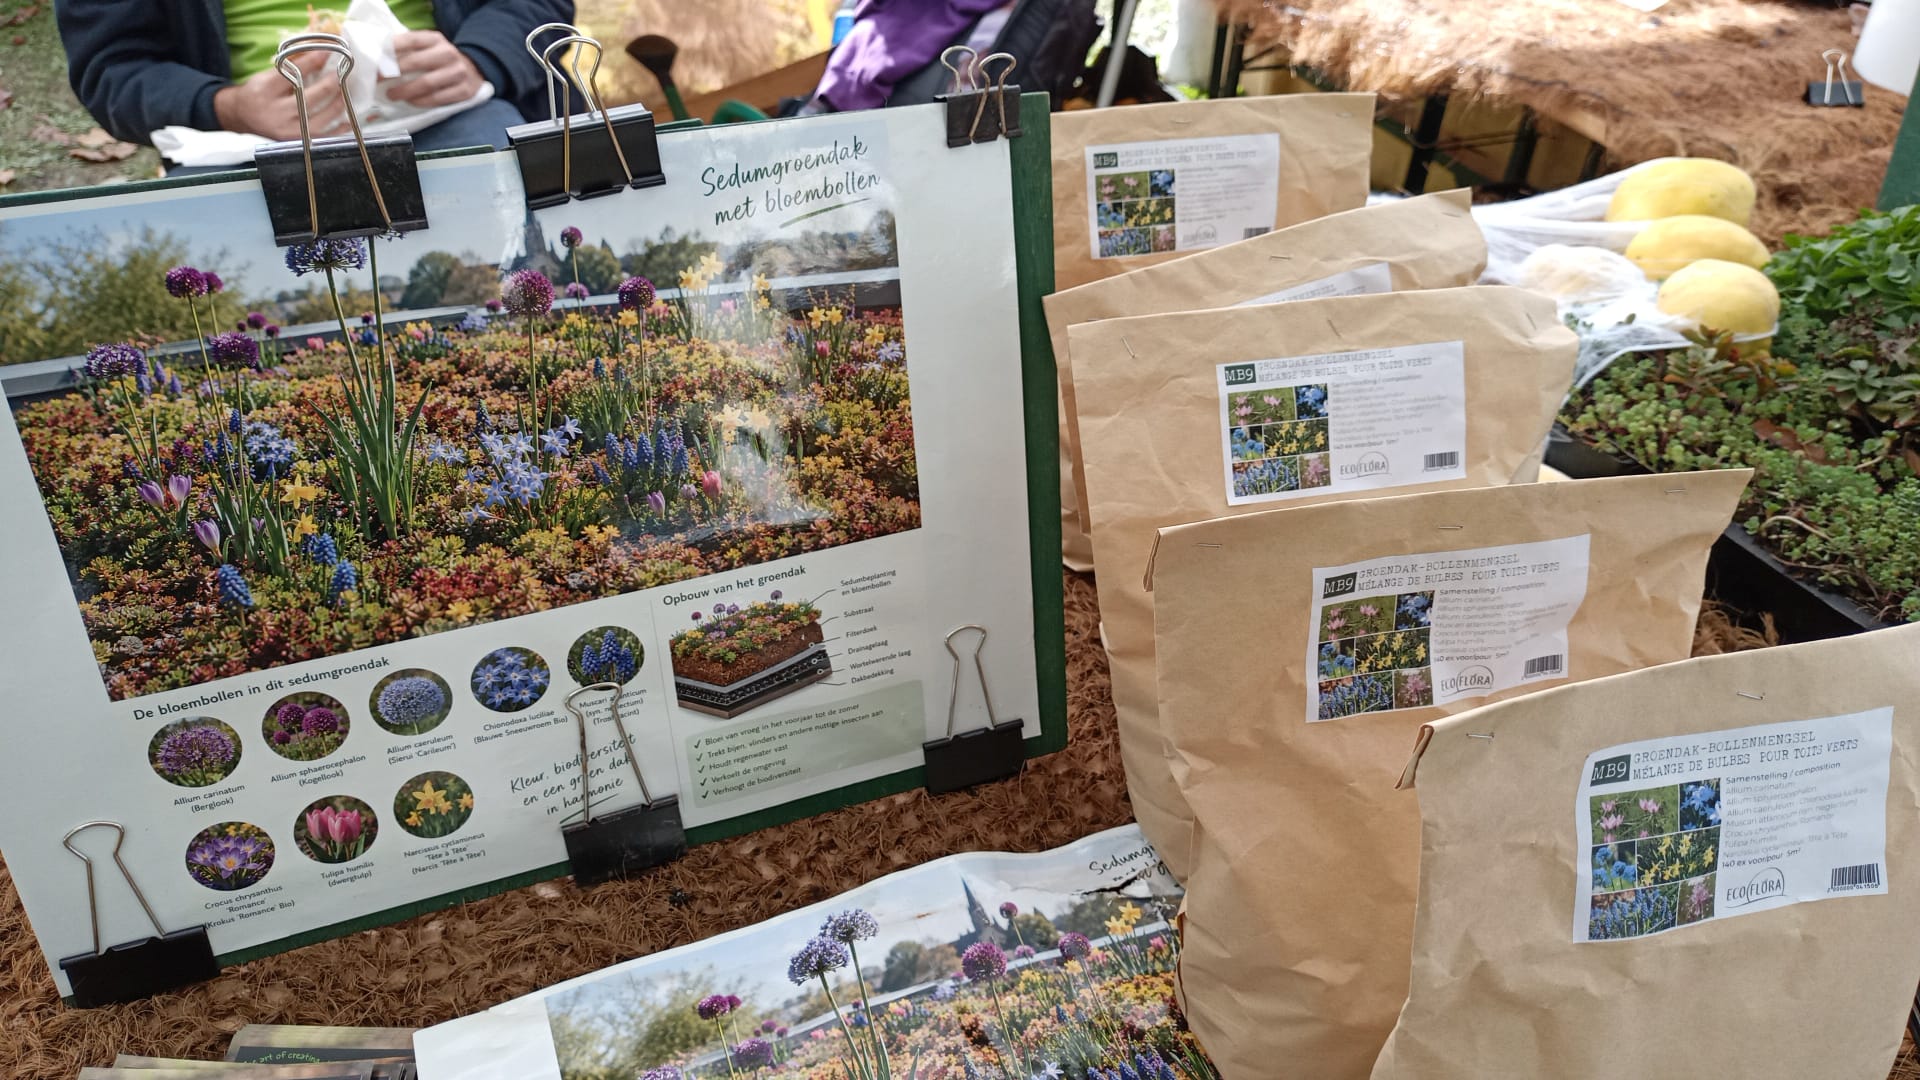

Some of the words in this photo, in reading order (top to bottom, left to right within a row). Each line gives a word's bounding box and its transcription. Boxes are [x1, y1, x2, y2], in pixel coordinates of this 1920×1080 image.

[701, 136, 867, 196] Sedumgroendak
[715, 196, 756, 226] met
[765, 172, 880, 213] bloembollen
[1225, 366, 1254, 382] MB9
[1340, 463, 1356, 475] ECO
[1359, 554, 1519, 578] GROENDAK-BOLLENMENGSEL
[1407, 576, 1420, 586] DE
[1424, 572, 1464, 584] BULBES
[1471, 569, 1497, 580] POUR
[1500, 565, 1527, 577] TOITS
[1531, 562, 1560, 574] VERTS
[663, 589, 710, 606] Opbouw
[713, 584, 733, 595] van
[736, 578, 754, 589] het
[758, 565, 806, 586] groendak
[840, 570, 896, 586] Sedumbeplanting
[852, 580, 891, 593] bloembollen
[1323, 577, 1354, 594] MB9
[1440, 586, 1495, 595] Samenstelling
[844, 606, 874, 617] Substraat
[846, 625, 877, 638] Filterdoek
[848, 640, 888, 654] Drainagelaag
[851, 668, 894, 683] Dakbedekking
[133, 708, 154, 720] De
[158, 688, 244, 716] bloembollen
[248, 684, 261, 695] in
[266, 679, 284, 691] dit
[288, 657, 390, 687] sedumgroendak
[579, 697, 607, 707] Muscari
[610, 689, 647, 701] atnticum
[604, 698, 643, 711] neectum)
[473, 732, 503, 744] (Blauwe
[505, 721, 551, 736] Sneeuwroem
[553, 715, 568, 725] Bio)
[483, 717, 527, 731] Chionodoxa
[529, 710, 555, 720] luciliae
[705, 736, 724, 746] Bloei
[725, 732, 739, 740] van
[740, 726, 761, 735] vroeg
[761, 722, 769, 730] in
[770, 719, 783, 728] het
[784, 714, 813, 724] voorjaar
[827, 708, 837, 716] de
[838, 705, 860, 714] zomer
[387, 744, 412, 754] Allium
[414, 735, 453, 747] caeruleum
[707, 749, 726, 759] Trekt
[748, 735, 776, 747] vlinders
[789, 725, 813, 736] andere
[814, 720, 840, 731] nuttige
[841, 713, 870, 724] insecten
[871, 710, 884, 718] aan
[554, 733, 637, 774] biodiersitet
[709, 760, 732, 770] Houdt
[733, 750, 772, 765] regenwater
[774, 744, 788, 752] vast
[1633, 731, 1816, 764] GROENDAK-BOLLENMENGSEL
[270, 770, 297, 783] Allium
[299, 755, 366, 778] sphaerocephalon
[388, 754, 413, 765] (Sierui
[1592, 759, 1627, 781] MB9
[1632, 761, 1685, 780] MÉLANGE
[1689, 760, 1703, 771] DE
[1707, 754, 1751, 769] BULBES
[1759, 750, 1789, 763] POUR
[1793, 745, 1824, 760] TOITS
[1826, 739, 1859, 753] VERTS
[298, 769, 343, 787] (Kogellook)
[711, 770, 741, 783] Verkoelt
[742, 767, 751, 775] de
[753, 758, 786, 772] omgeving
[1726, 771, 1788, 784] Samenstelling
[1795, 761, 1841, 776] composition
[522, 795, 540, 807] en
[543, 783, 566, 798] een
[570, 767, 605, 791] gren
[713, 783, 745, 796] Verhoogt
[746, 779, 756, 787] de
[757, 767, 802, 784] biodiversiteit
[173, 793, 201, 806] Allium
[203, 785, 245, 801] carinatum
[191, 797, 234, 813] (Berglook)
[547, 803, 559, 815] in
[404, 845, 439, 857] Narcissus
[441, 833, 485, 848] cyclamineus
[321, 869, 345, 879] Tulipa
[346, 862, 374, 872] humilis
[411, 863, 438, 875] (Narcis
[1722, 860, 1735, 868] 140
[328, 870, 372, 887] (dwergtulp)
[204, 899, 233, 910] Crocus
[235, 886, 283, 902] chrysanthus
[1726, 886, 1746, 901] ECO
[204, 917, 235, 929] (Krokus
[279, 899, 295, 910] Bio)
[275, 1051, 287, 1060] of
